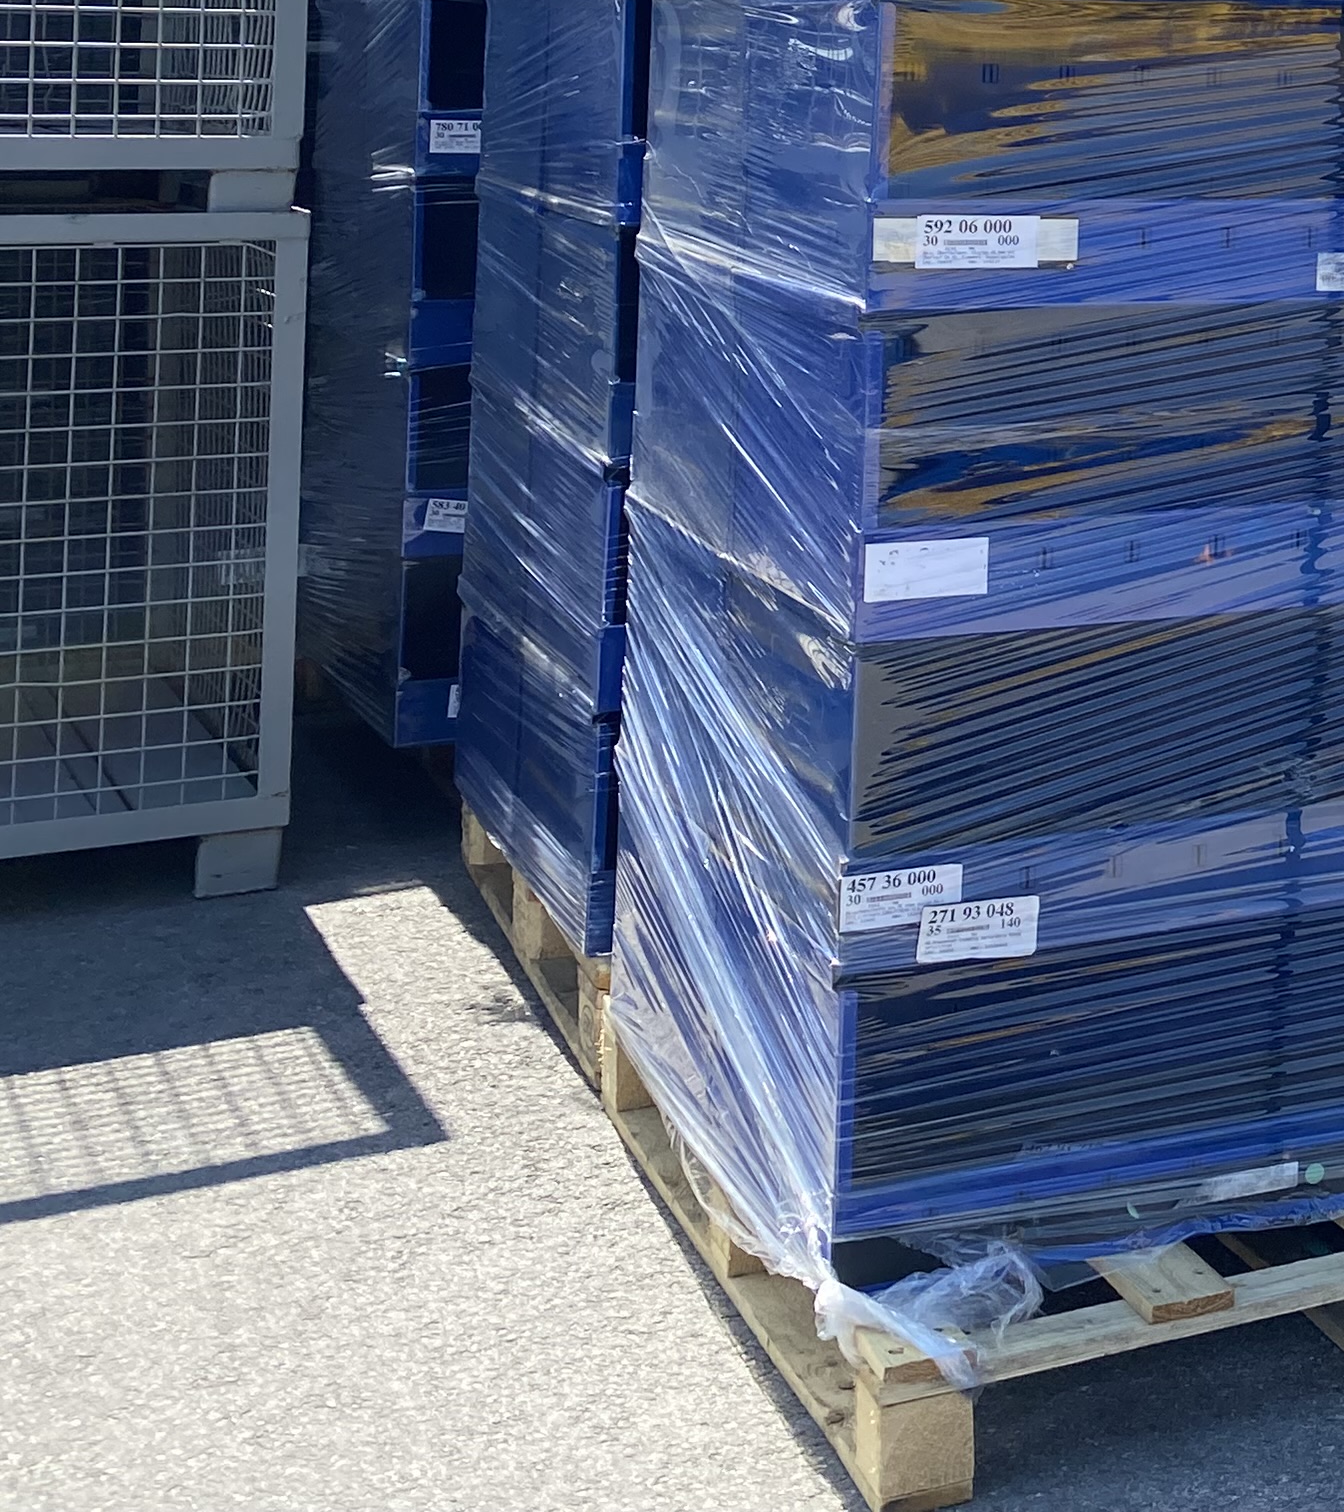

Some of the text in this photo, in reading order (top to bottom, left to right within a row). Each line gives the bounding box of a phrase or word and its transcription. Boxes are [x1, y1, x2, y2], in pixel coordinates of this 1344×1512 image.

[456, 122, 469, 132] 71
[923, 219, 1012, 234] 592 06 000
[922, 235, 1019, 247] 30 000
[846, 869, 936, 894] 457 36 000
[846, 883, 944, 907] 30 000
[928, 909, 956, 925] 271
[962, 906, 981, 921] 93
[986, 902, 1015, 919] 048
[926, 916, 1021, 937] 35 140
